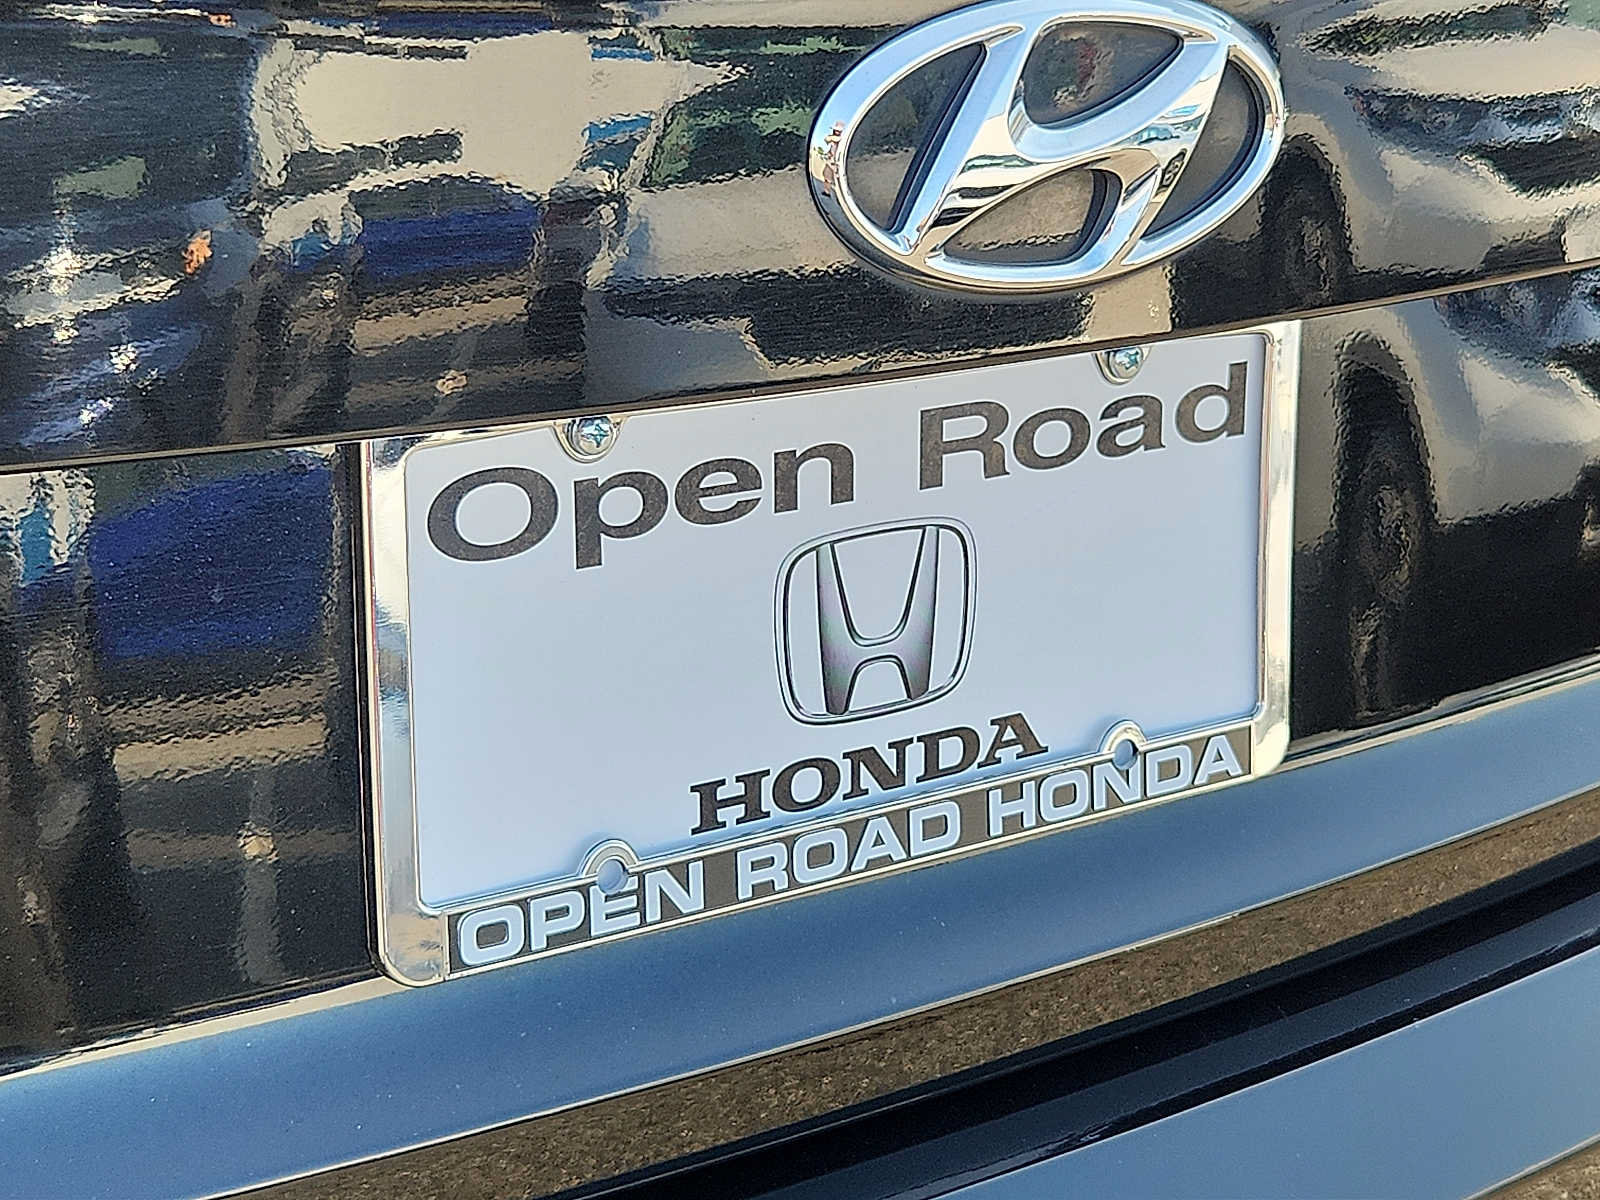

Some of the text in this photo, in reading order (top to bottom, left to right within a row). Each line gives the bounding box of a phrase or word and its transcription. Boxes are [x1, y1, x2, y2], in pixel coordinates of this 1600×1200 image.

[427, 360, 1249, 569] Open Road
[457, 735, 1243, 967] OPEN ROAD HONDA
[689, 712, 1049, 836] HONDA
